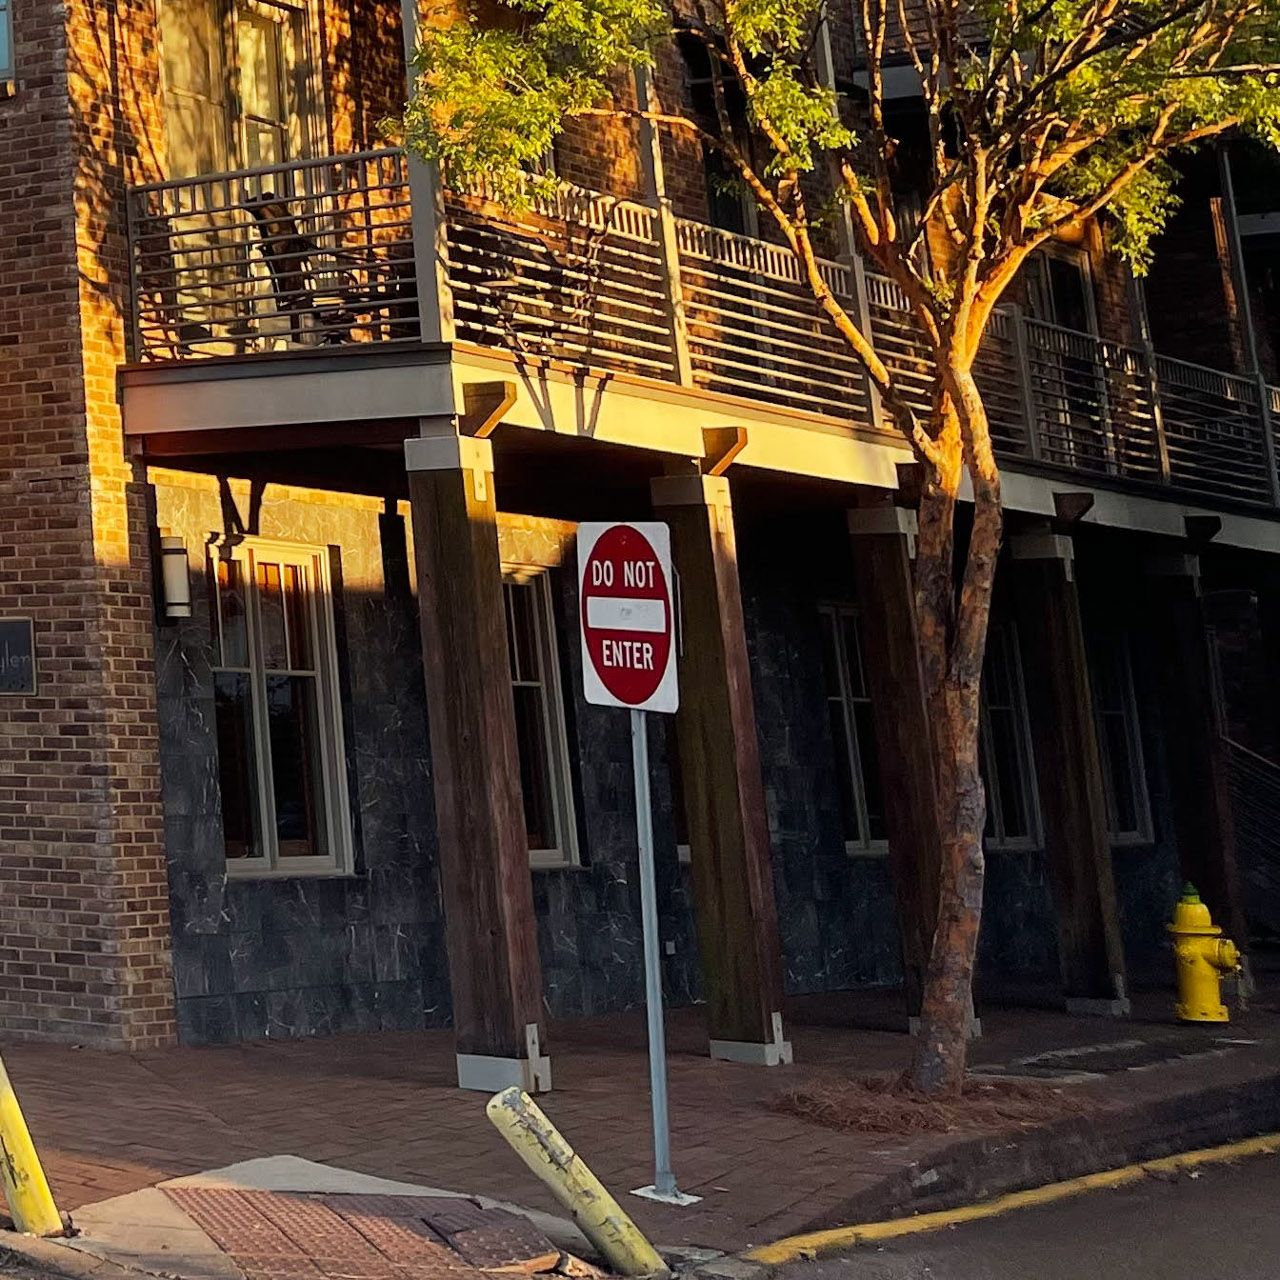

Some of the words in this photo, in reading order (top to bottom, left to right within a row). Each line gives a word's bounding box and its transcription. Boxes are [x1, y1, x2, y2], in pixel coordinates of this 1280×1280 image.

[592, 560, 614, 587] DO
[623, 561, 655, 588] NOT
[602, 639, 654, 670] ENTER
